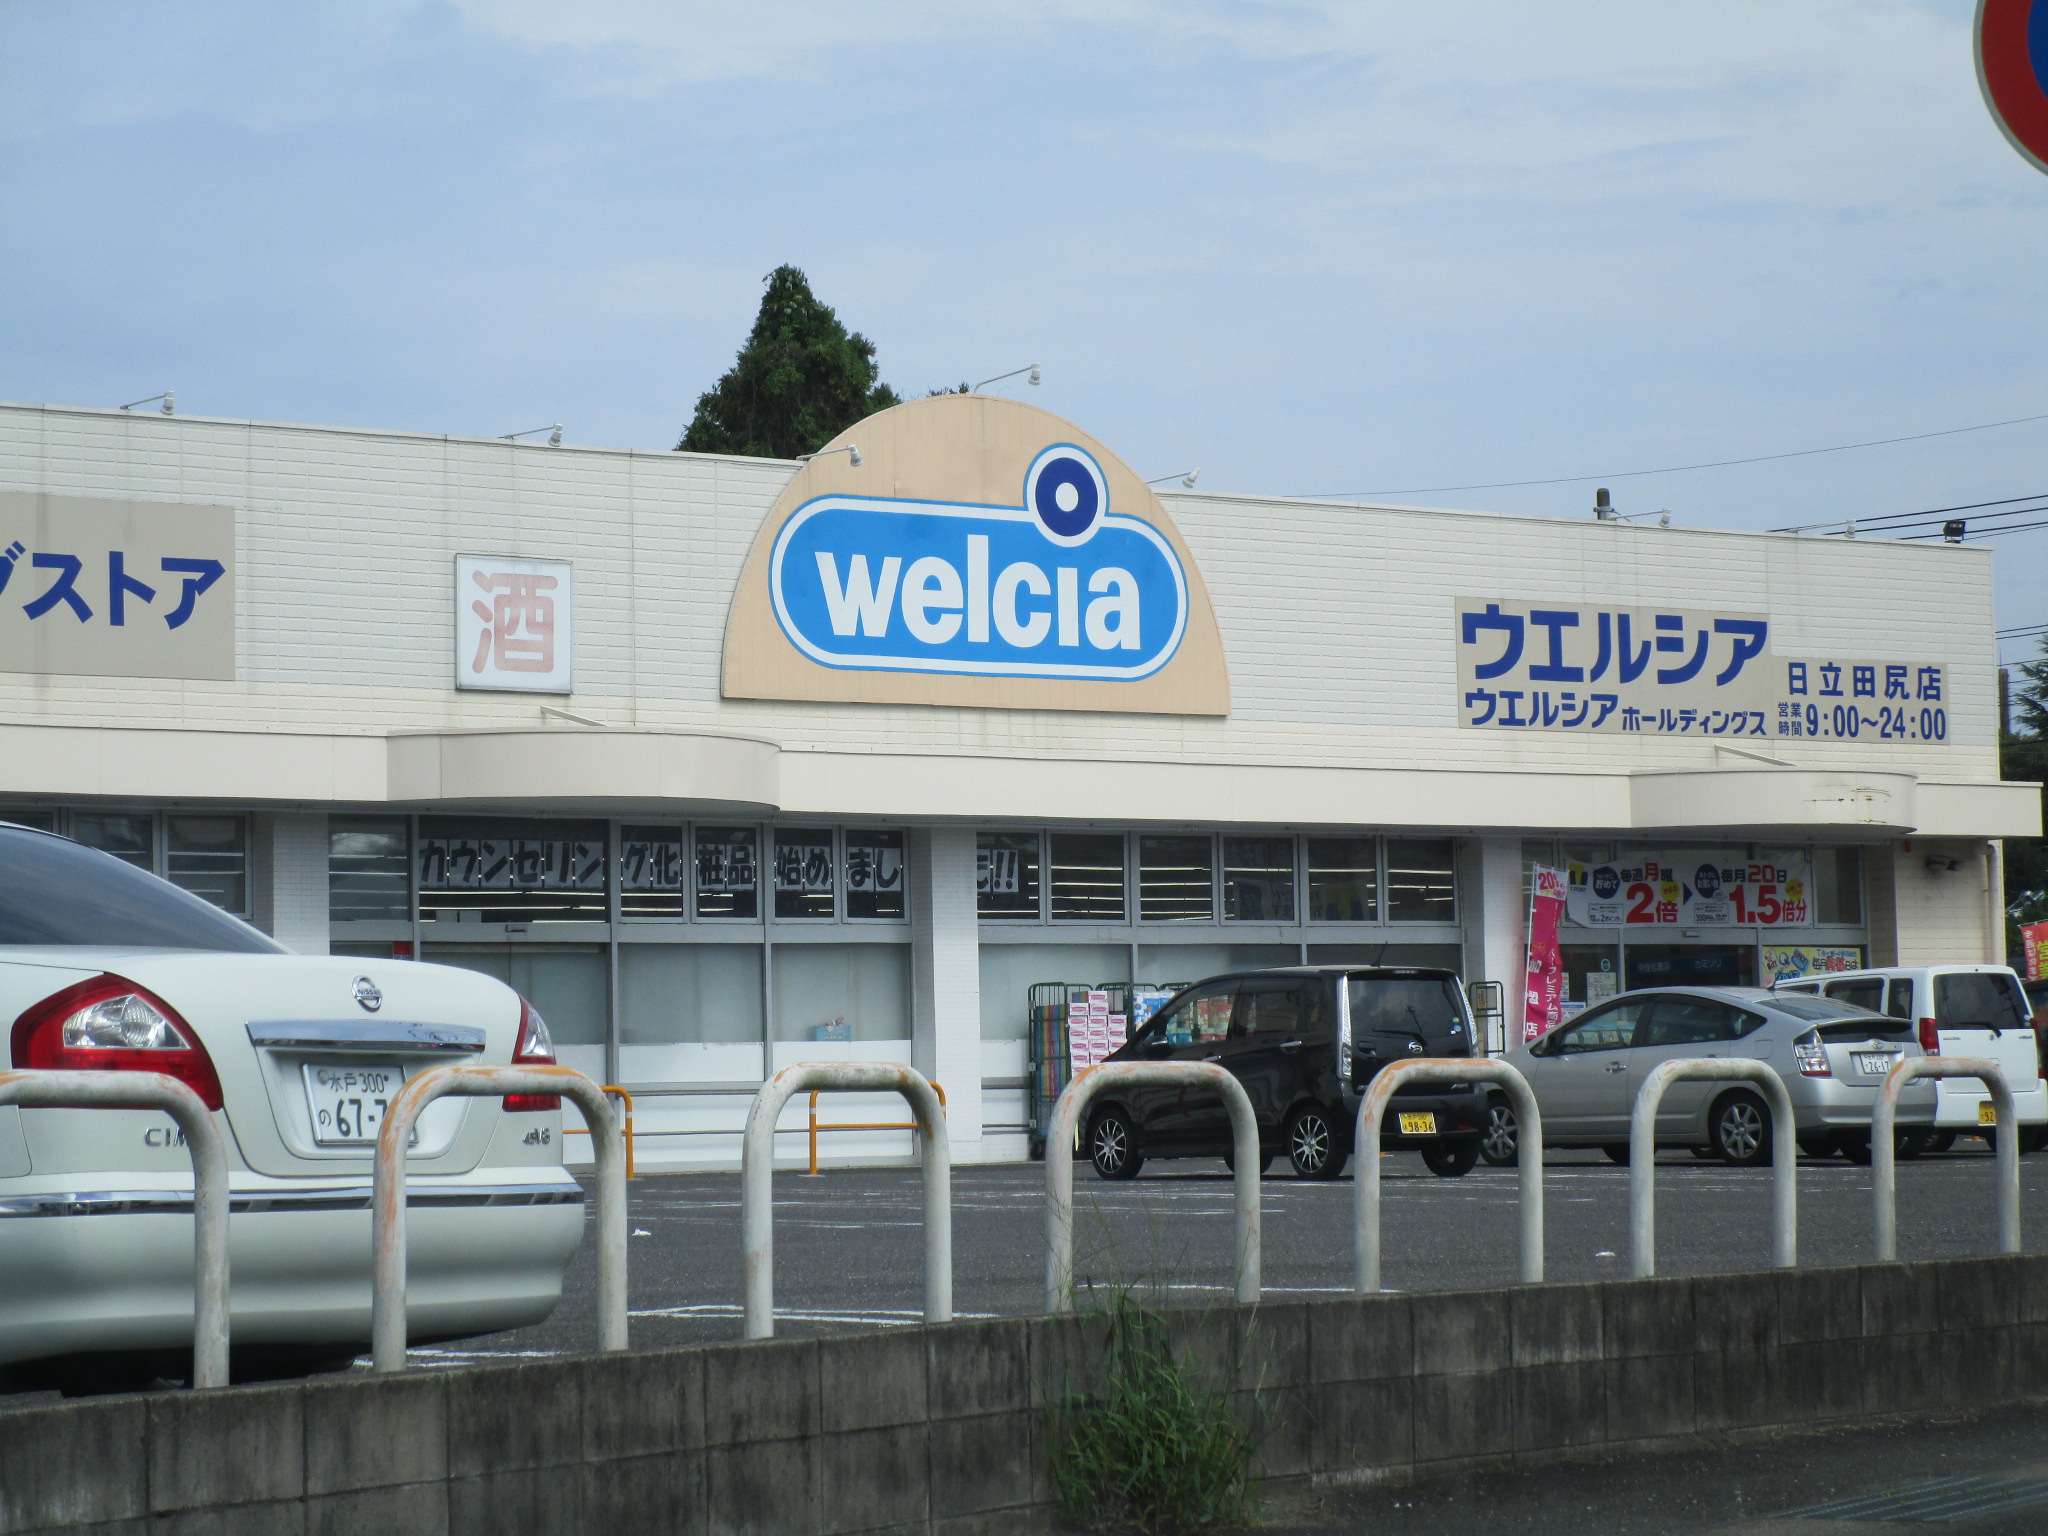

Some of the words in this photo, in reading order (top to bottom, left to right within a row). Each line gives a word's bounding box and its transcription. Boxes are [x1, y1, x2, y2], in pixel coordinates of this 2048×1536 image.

[471, 568, 559, 675] 酒
[815, 533, 1141, 651] welcia
[1461, 603, 1768, 687] ウエルシア
[1787, 661, 1942, 702] 日立田尻店
[1721, 864, 1787, 884] 毎月20日
[318, 1108, 332, 1127] の
